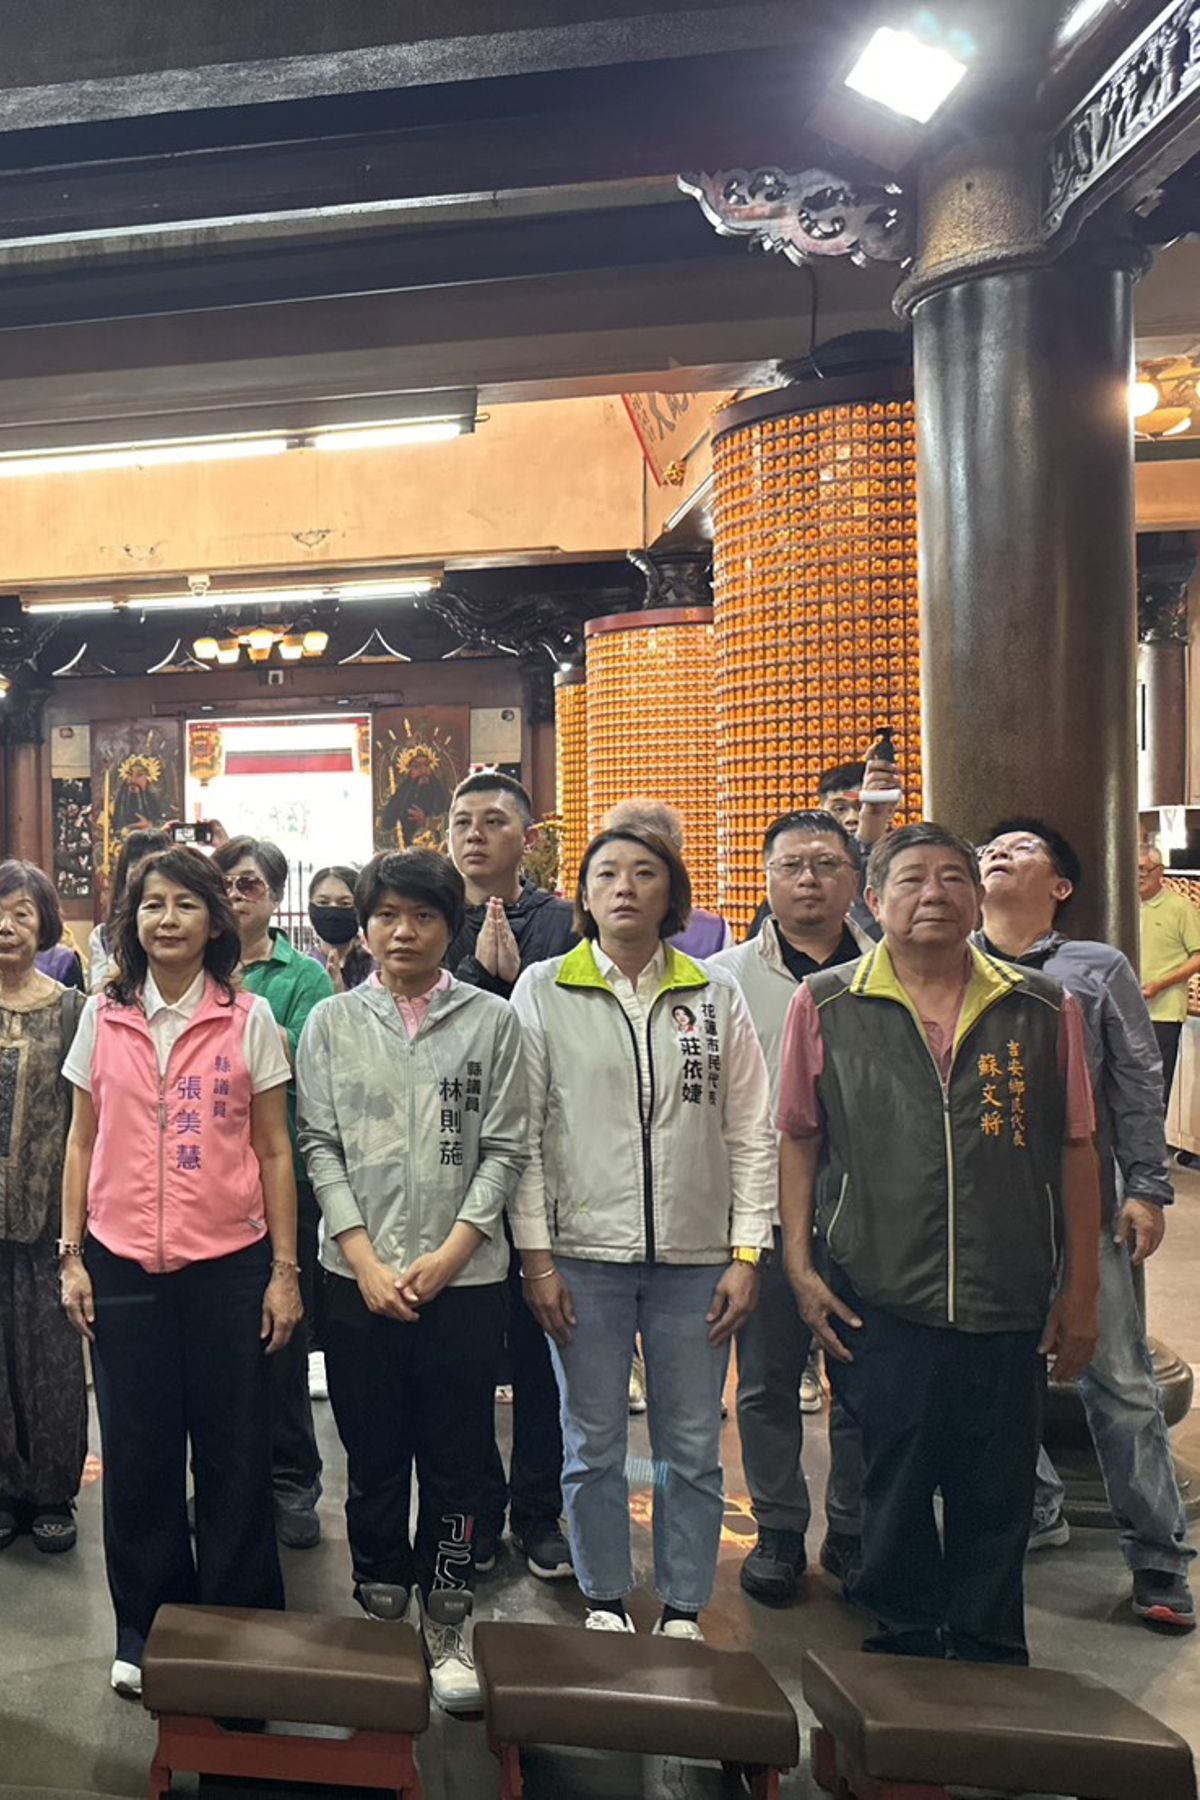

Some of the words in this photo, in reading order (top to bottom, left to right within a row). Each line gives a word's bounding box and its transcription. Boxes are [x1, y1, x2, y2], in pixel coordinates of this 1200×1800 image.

[213, 1055, 231, 1118] 縣議員
[464, 1060, 482, 1113] 縣議員
[680, 1036, 703, 1104] 莊依婕
[176, 1076, 202, 1170] 張美慧
